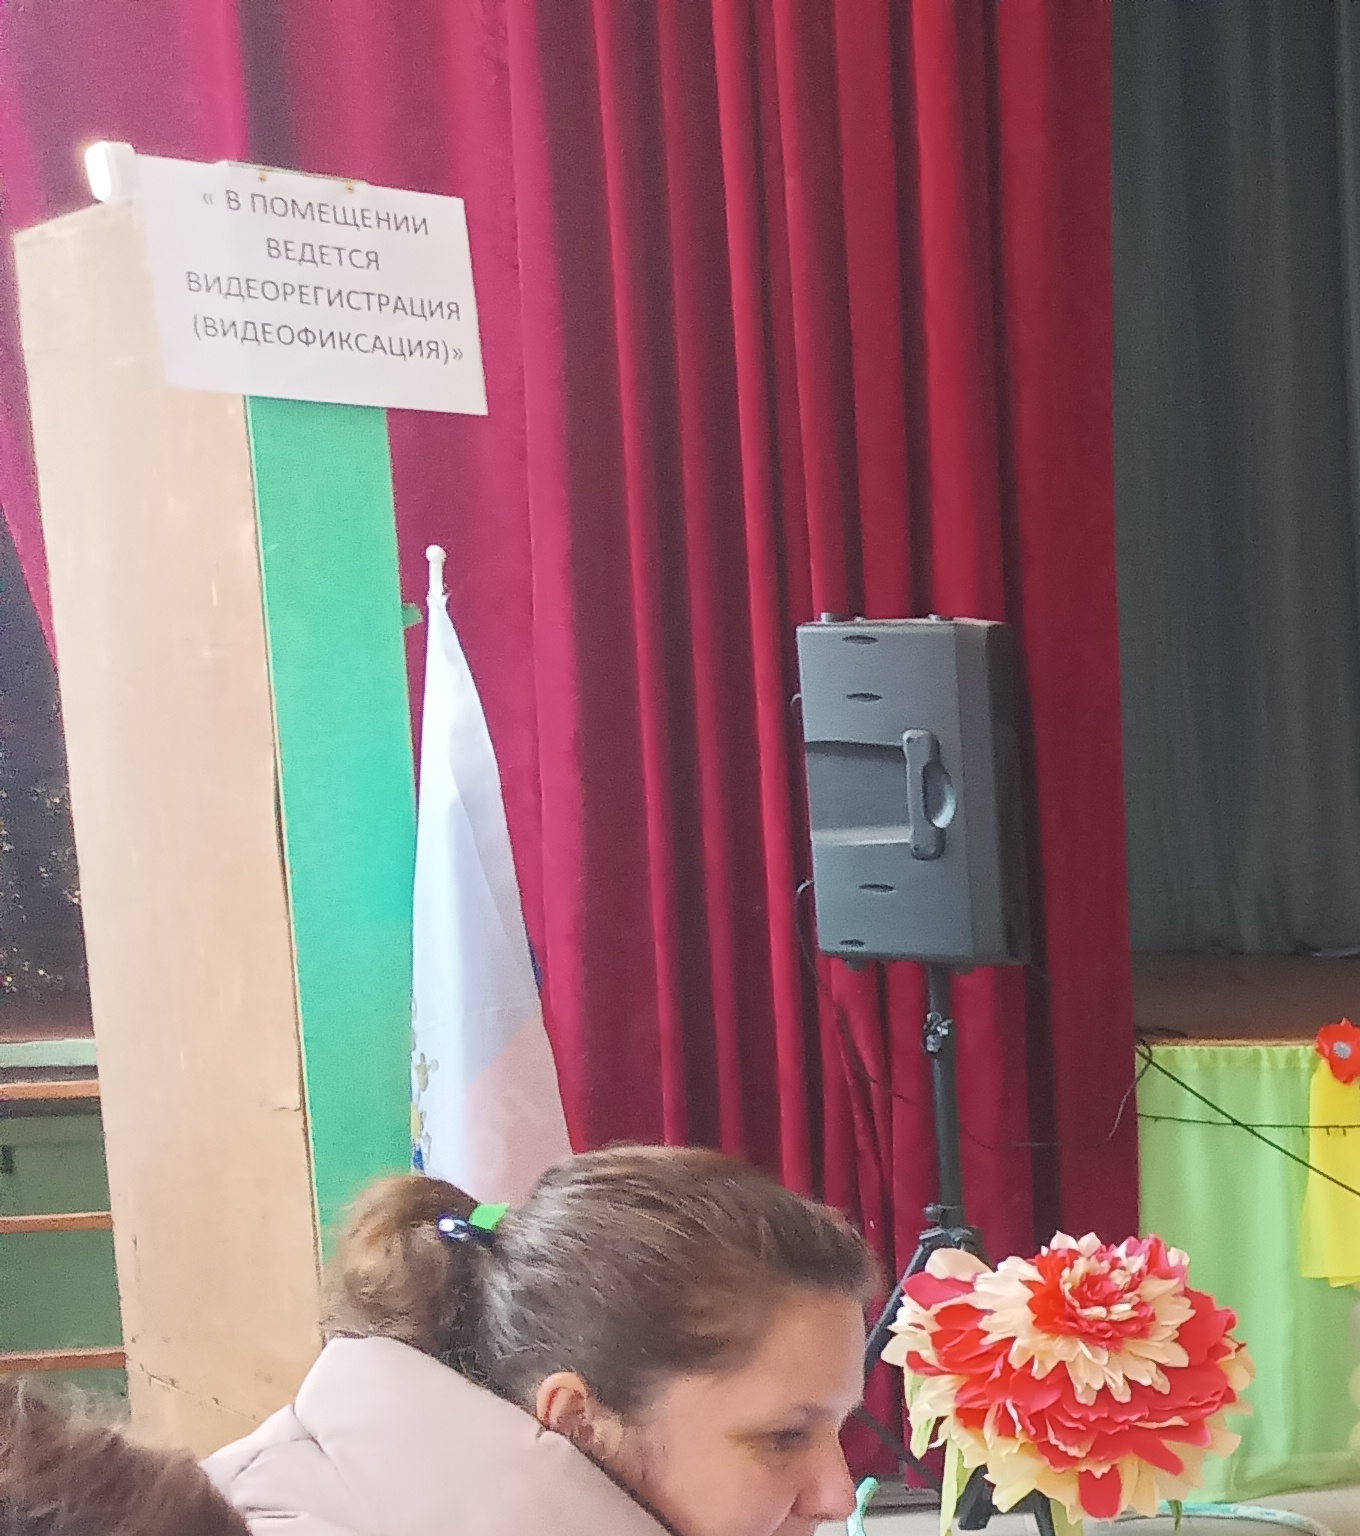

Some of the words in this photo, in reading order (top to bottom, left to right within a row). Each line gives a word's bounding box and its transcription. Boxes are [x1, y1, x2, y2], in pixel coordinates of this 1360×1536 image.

[225, 189, 241, 211] В
[250, 193, 429, 236] ПОМЕЩЕНИИ
[266, 237, 380, 270] ВЕДЕТСЯ
[186, 271, 461, 322] ВИДЕОРЕГИСТРАЦИЯ
[192, 314, 464, 365] (ВИДЕОФИКСАЦИЯ)»
